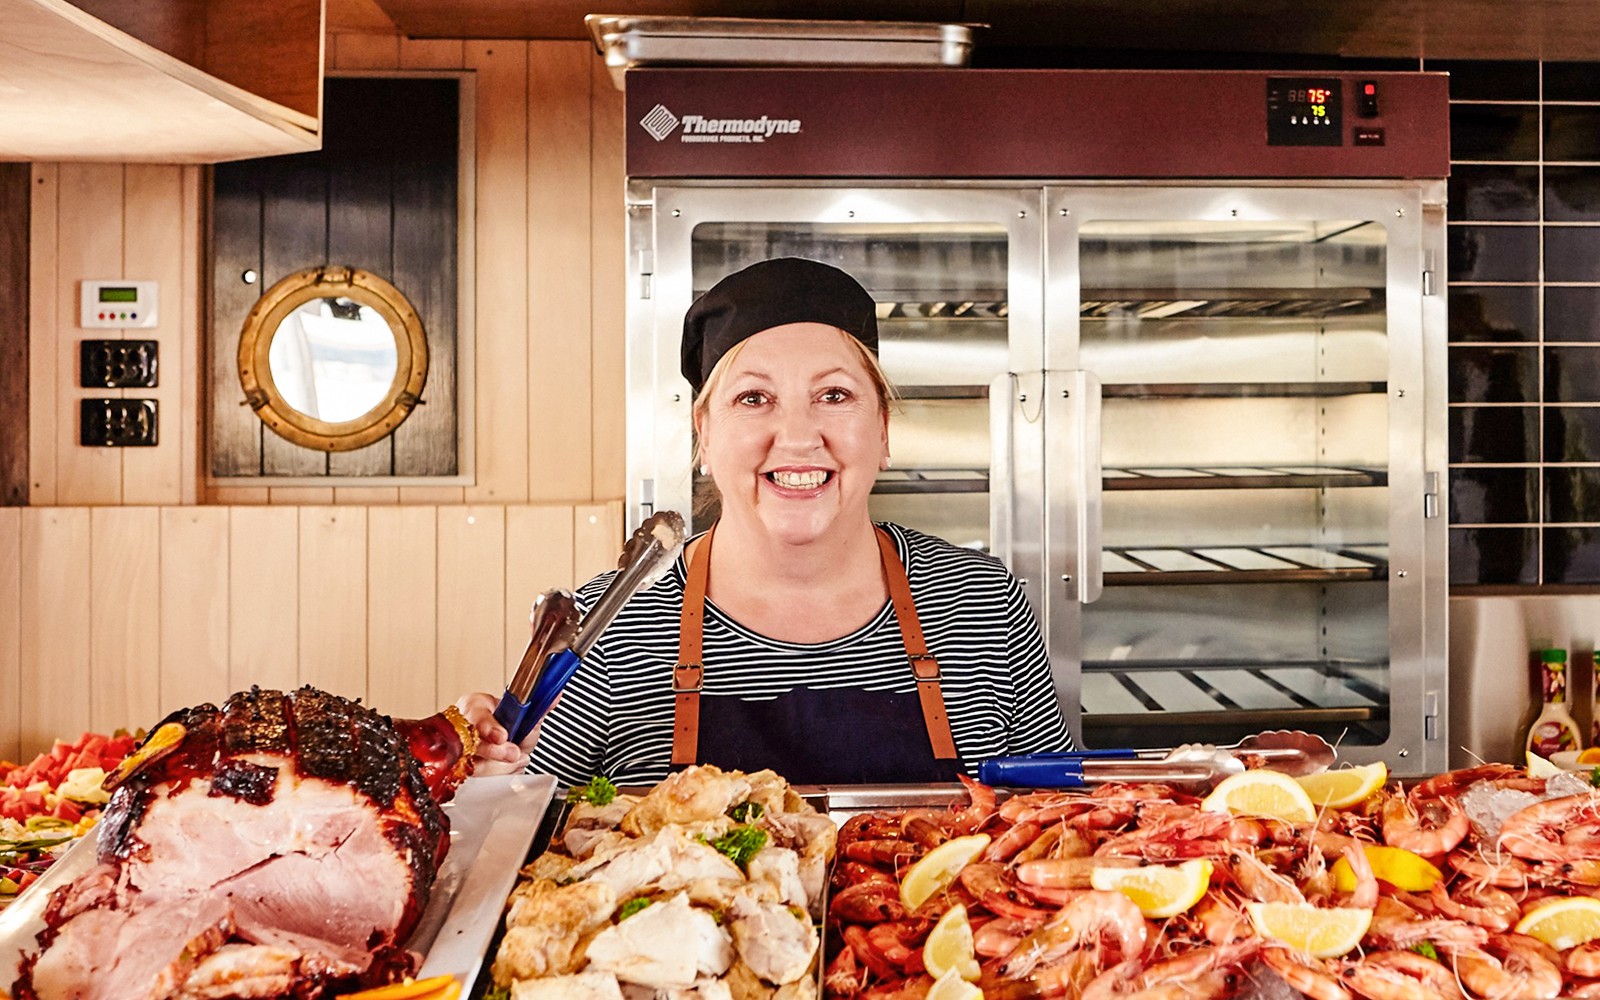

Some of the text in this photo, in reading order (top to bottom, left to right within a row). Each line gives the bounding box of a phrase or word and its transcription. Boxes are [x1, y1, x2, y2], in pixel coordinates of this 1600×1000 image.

[1311, 105, 1326, 117] 75
[681, 115, 801, 137] Thermodyne
[681, 135, 719, 143] FOODSERVICE
